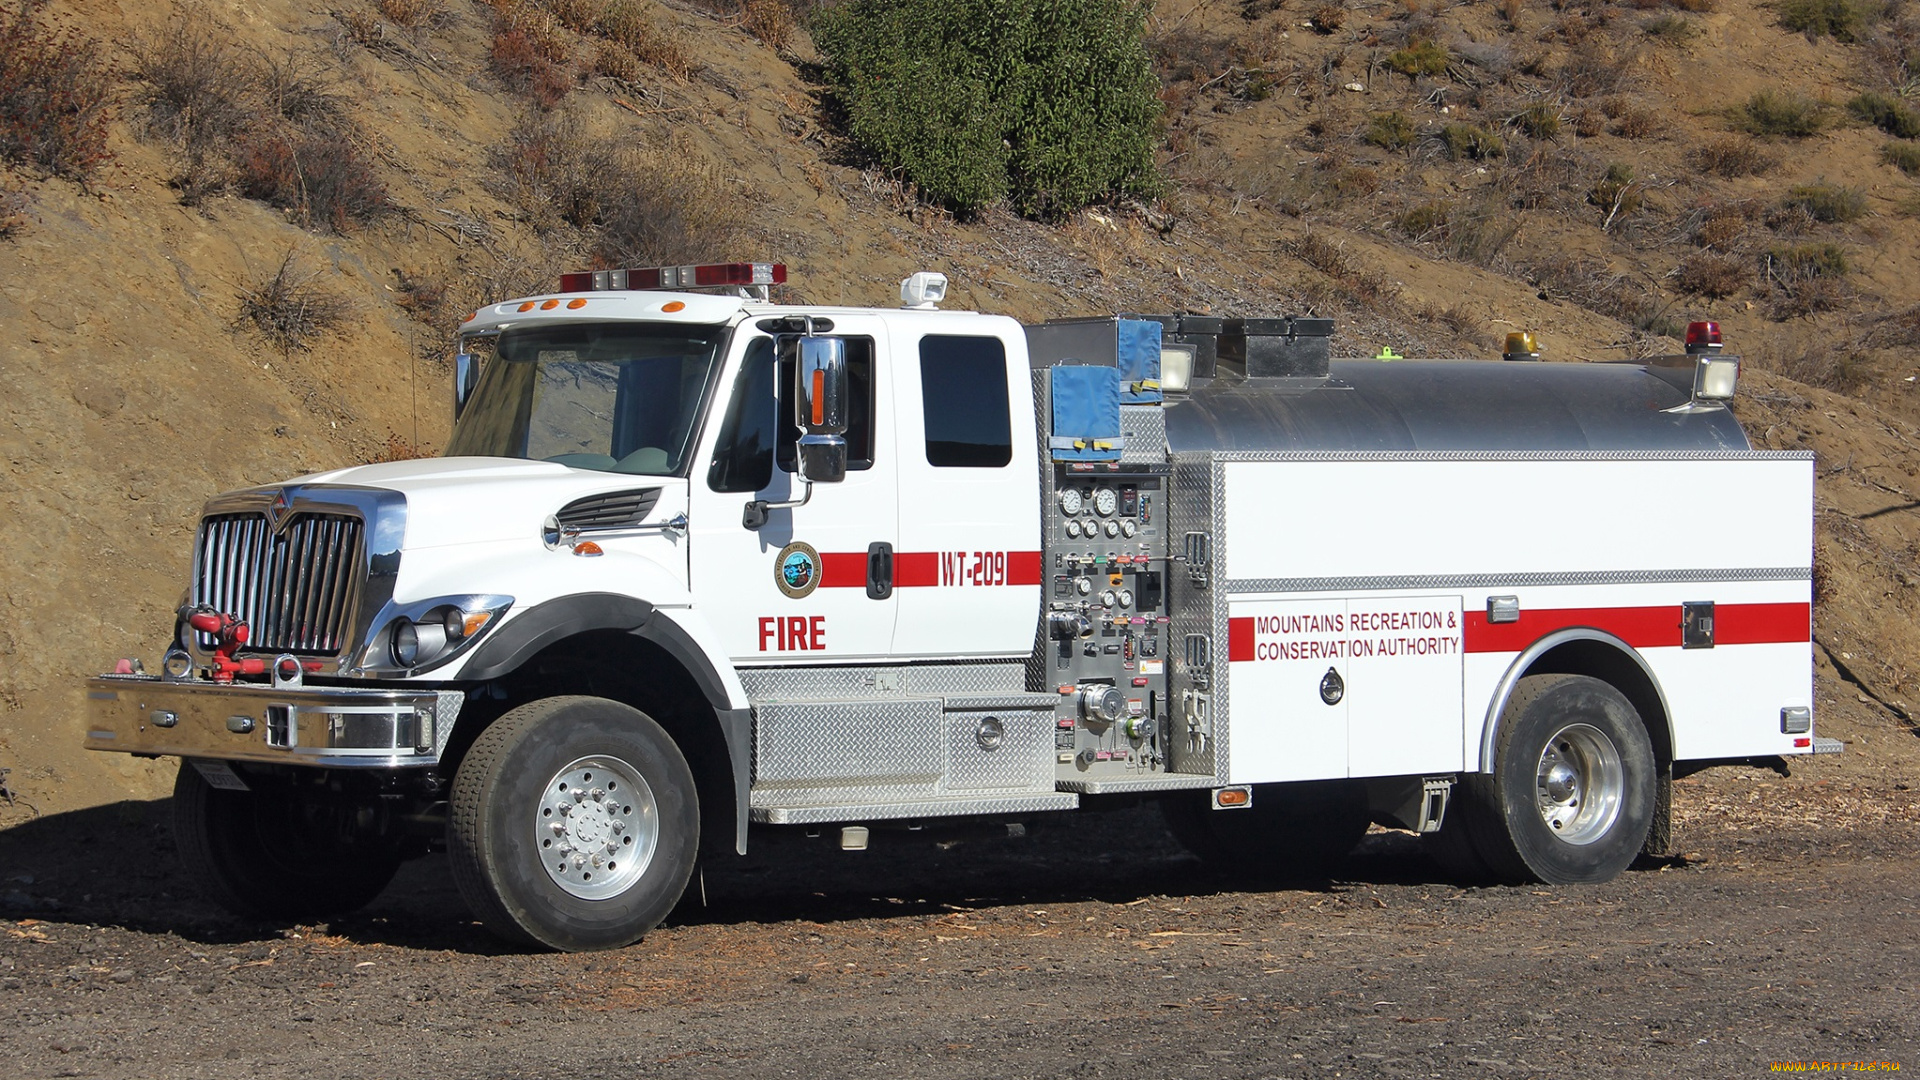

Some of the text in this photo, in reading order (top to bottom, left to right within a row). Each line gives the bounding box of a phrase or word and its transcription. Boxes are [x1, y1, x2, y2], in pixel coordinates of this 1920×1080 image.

[942, 551, 1005, 587] WT-209
[758, 615, 826, 652] FIRE
[1257, 611, 1457, 634] MOUNTAINS RECREATION &
[1257, 636, 1459, 661] CONSERVATION AUTHORITY
